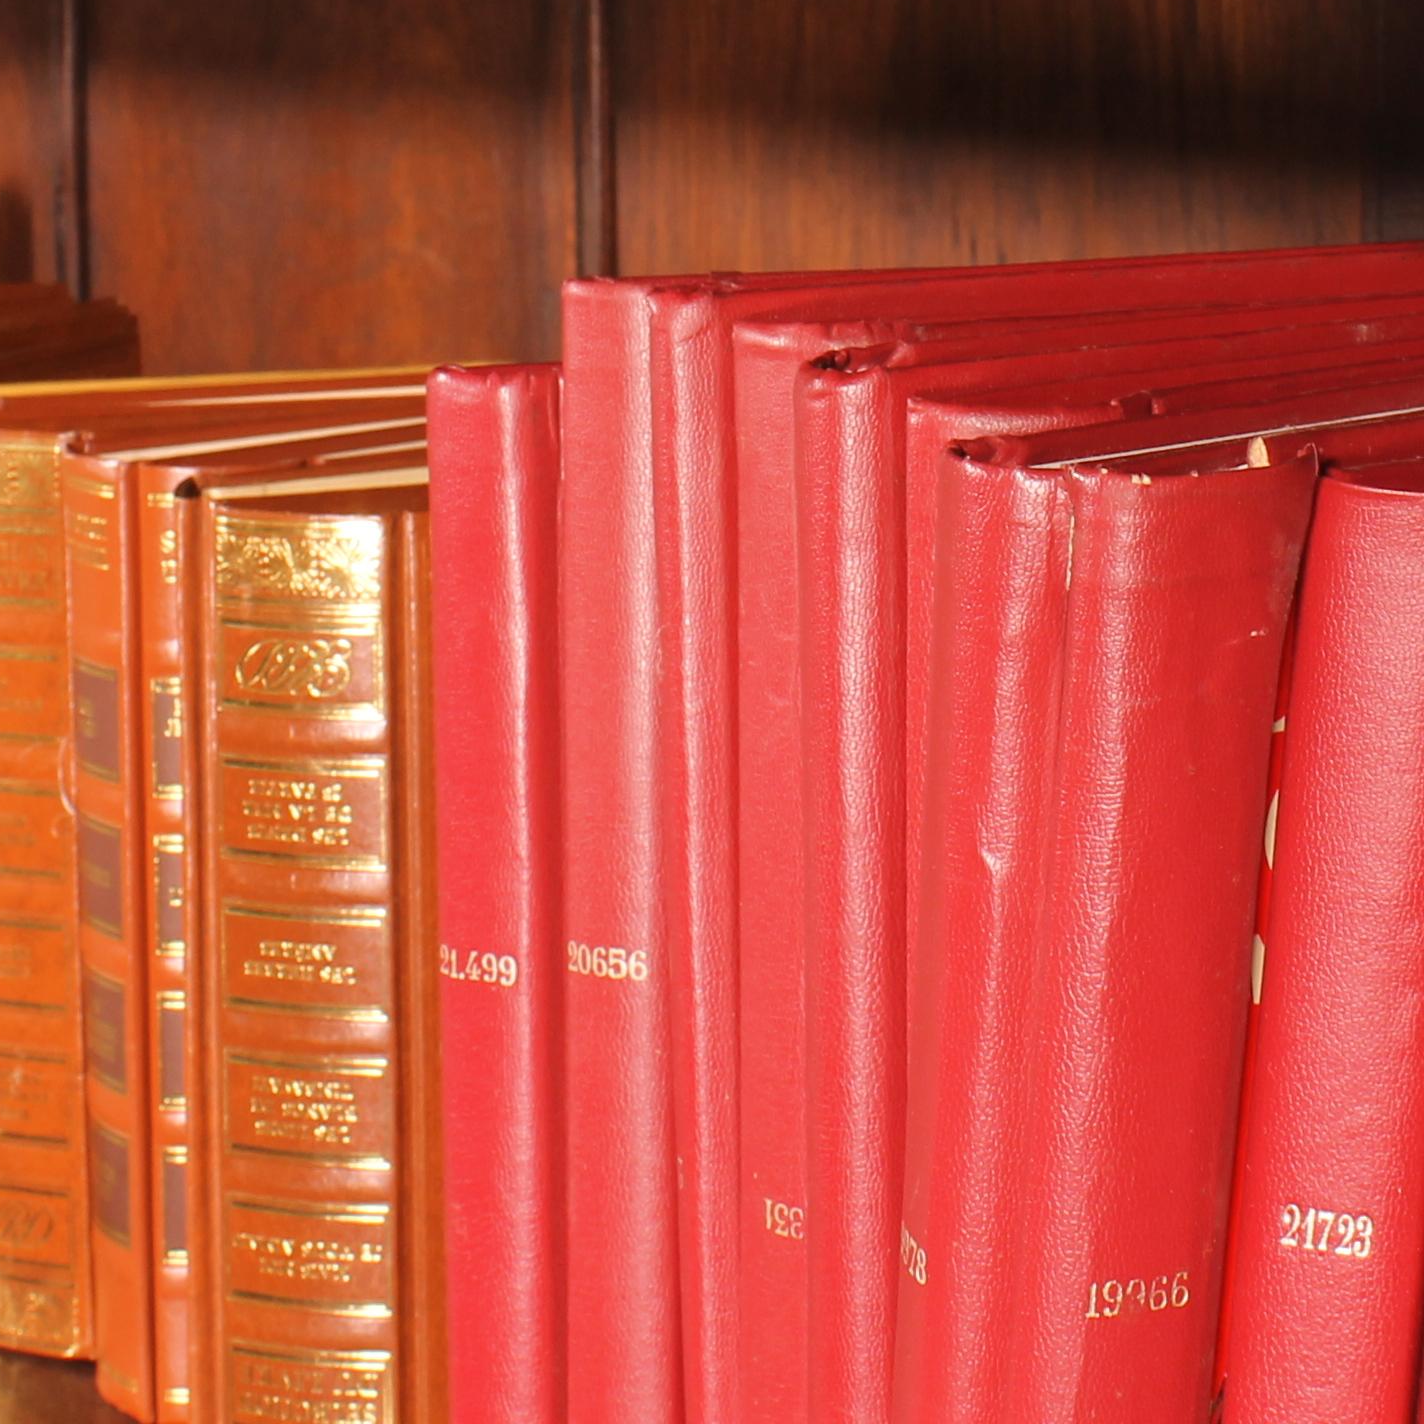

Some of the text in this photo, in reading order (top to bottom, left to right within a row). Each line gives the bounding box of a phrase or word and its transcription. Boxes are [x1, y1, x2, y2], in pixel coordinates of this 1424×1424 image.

[439, 943, 518, 987] 21.499
[567, 939, 648, 982] 20656
[1280, 1203, 1374, 1258] 21723
